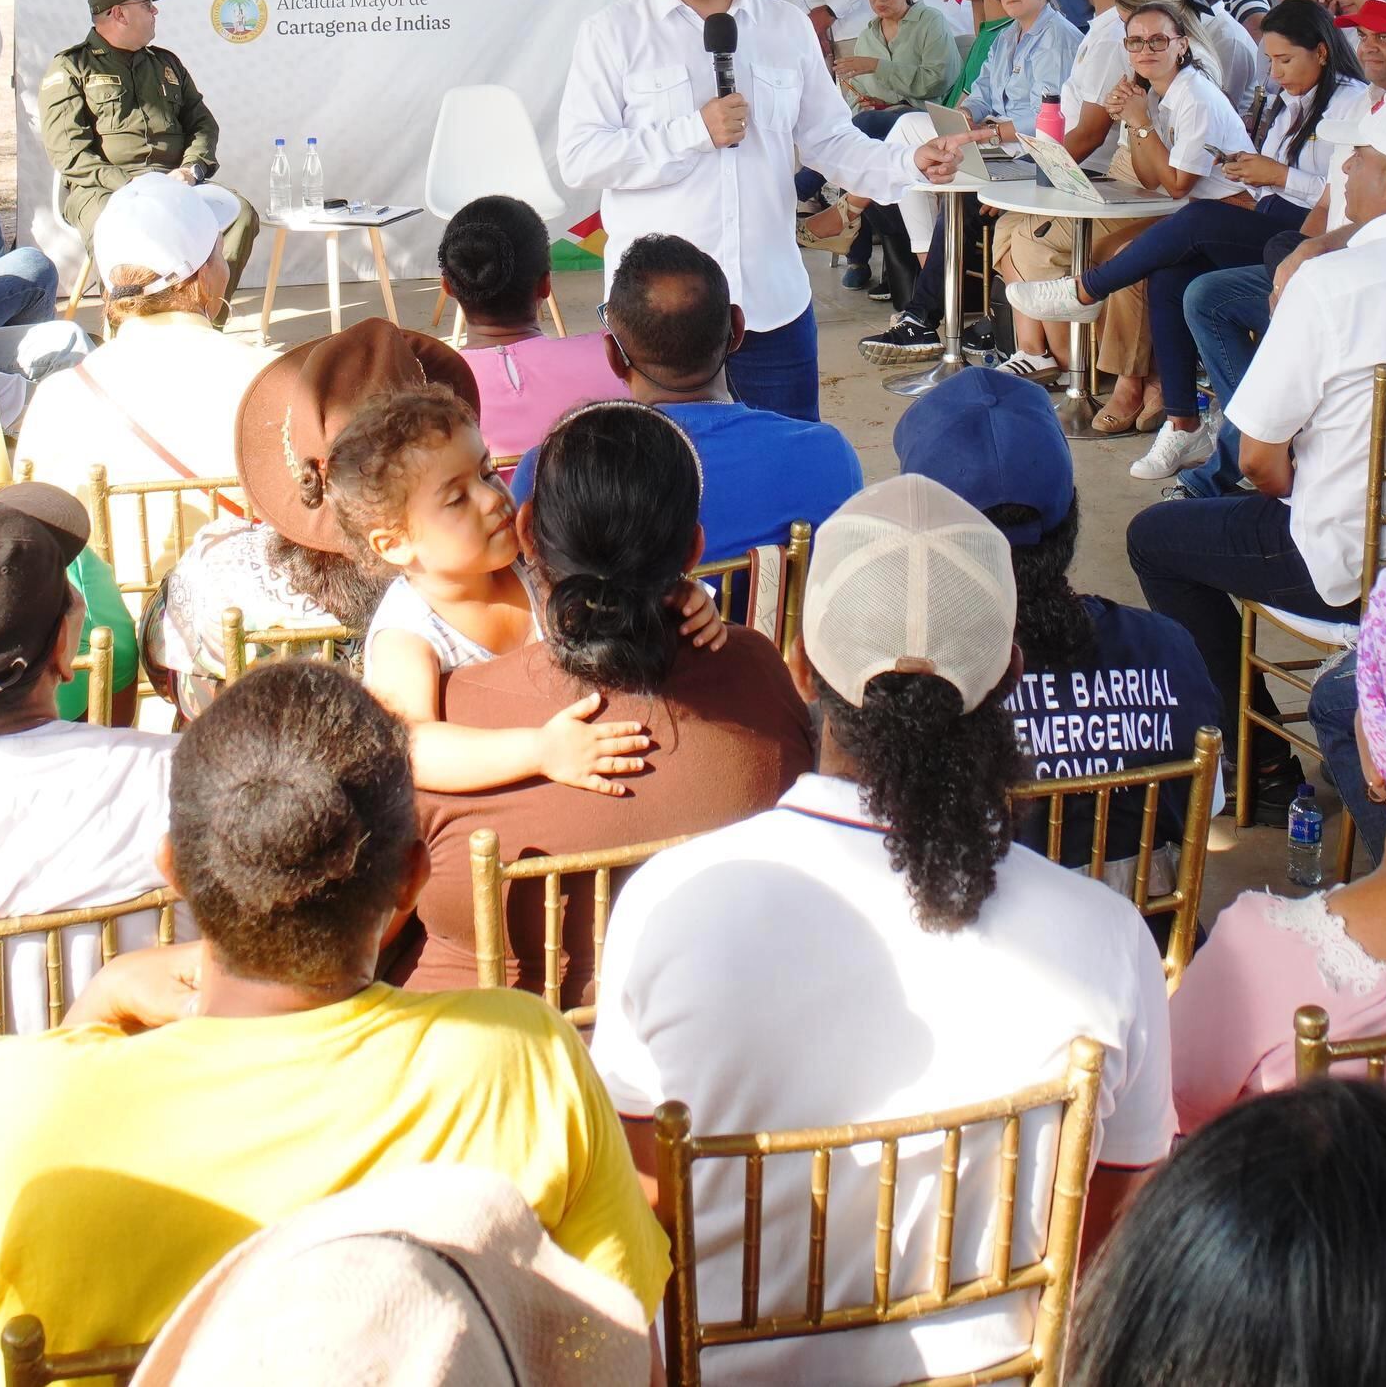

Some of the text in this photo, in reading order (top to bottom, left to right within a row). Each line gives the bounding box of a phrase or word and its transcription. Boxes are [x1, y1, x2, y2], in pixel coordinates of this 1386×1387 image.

[277, 15, 451, 37] Cartagena de Indias
[1072, 668, 1179, 707] BARRIAL
[1013, 712, 1174, 756] EMERGENCIA
